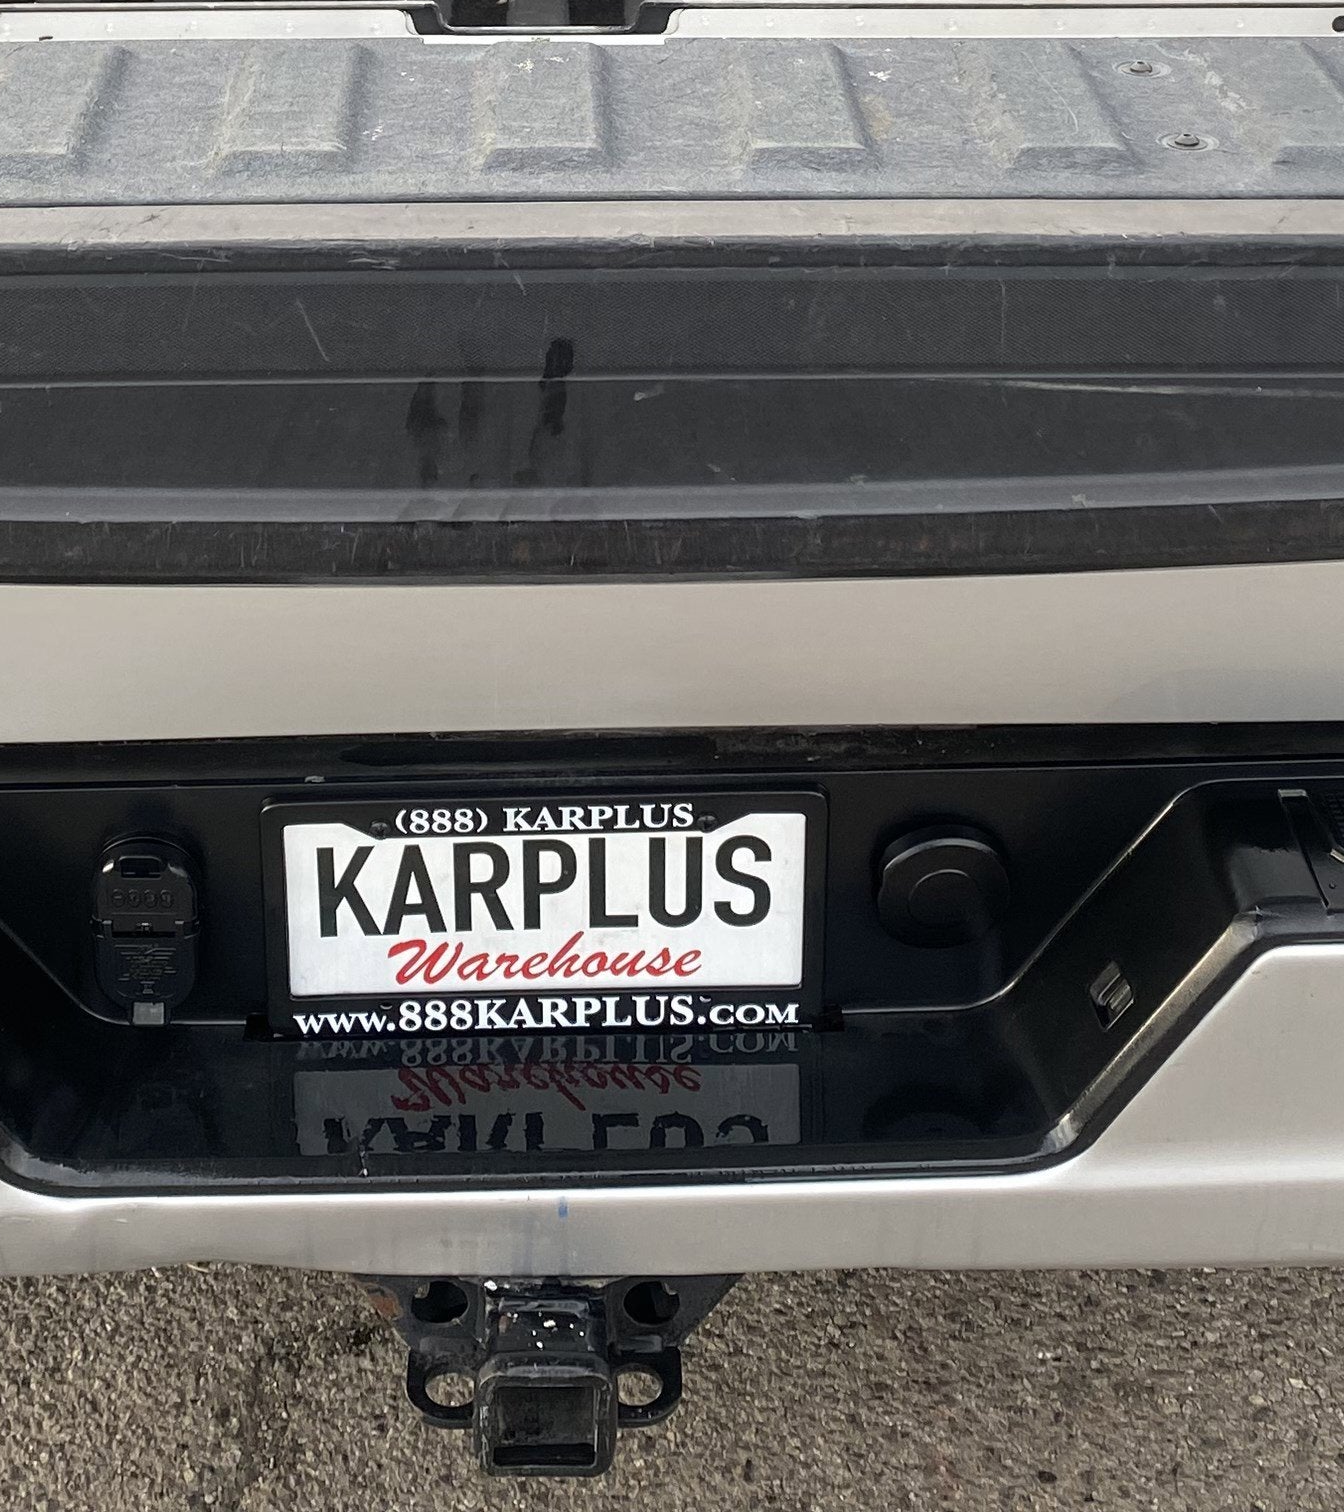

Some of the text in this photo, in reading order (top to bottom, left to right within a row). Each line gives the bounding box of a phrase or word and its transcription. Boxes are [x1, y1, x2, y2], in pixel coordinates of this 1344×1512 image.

[396, 803, 694, 835] (888) KARPLUS
[316, 834, 773, 938] KARPLUS
[387, 931, 702, 985] Warehouse
